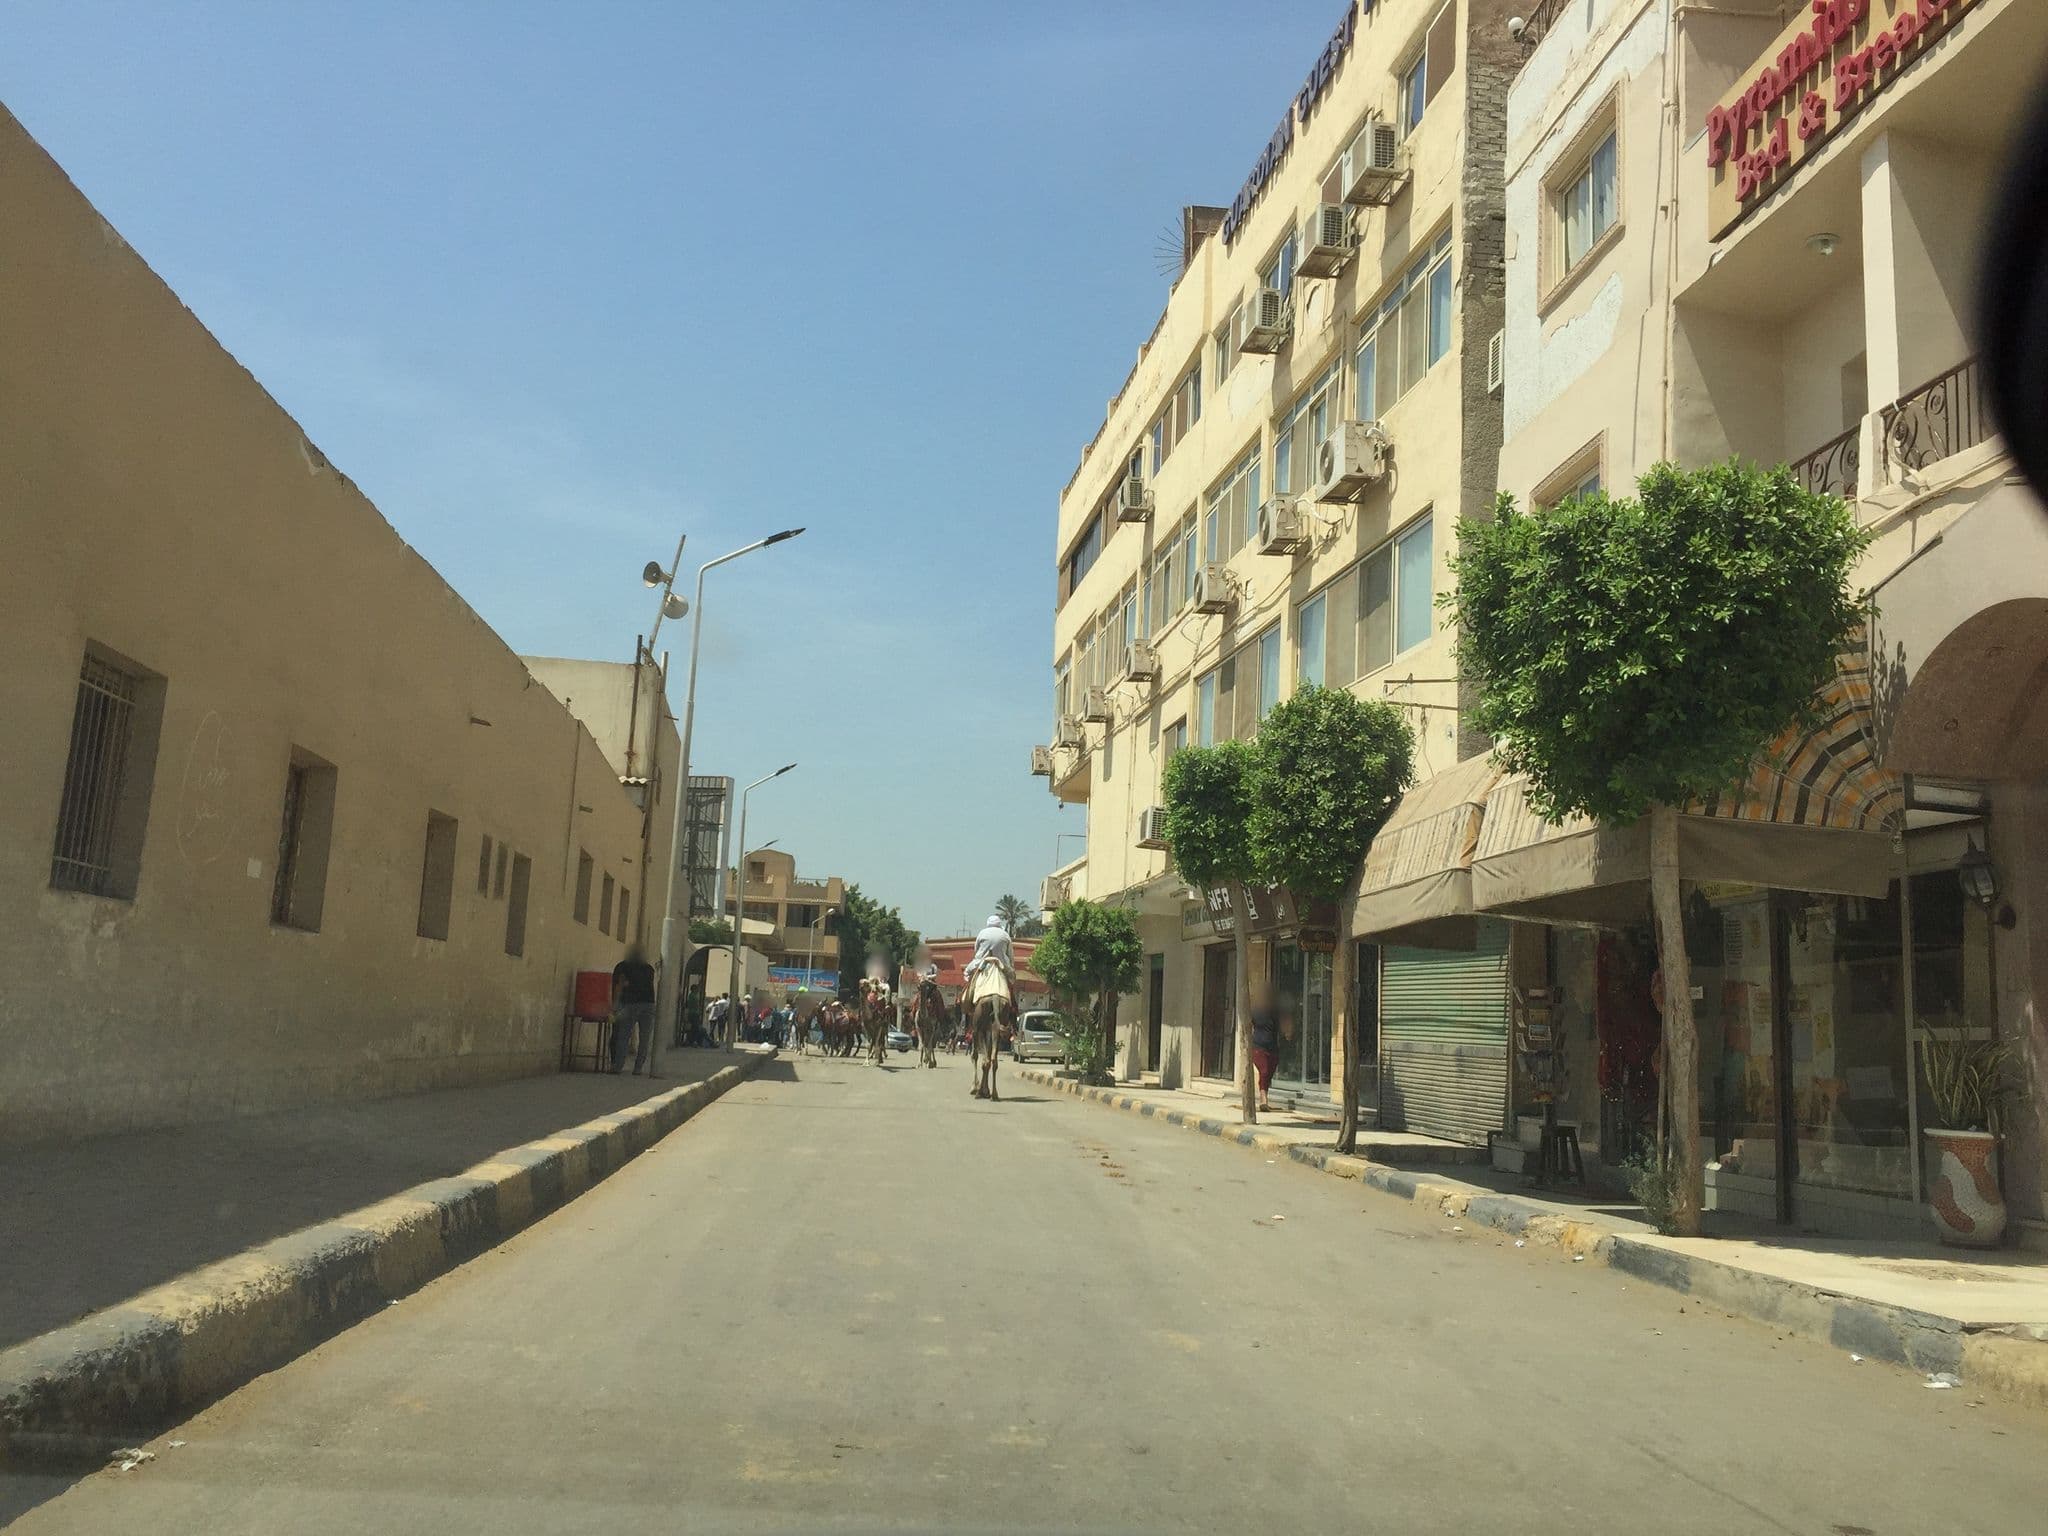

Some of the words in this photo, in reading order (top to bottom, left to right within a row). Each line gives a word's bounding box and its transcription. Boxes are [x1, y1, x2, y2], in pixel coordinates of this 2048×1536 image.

[1222, 106, 1294, 245] GUARDIAN
[1297, 0, 1358, 122] GUEST
[1735, 118, 1791, 202] Bed
[1798, 91, 1827, 141] &
